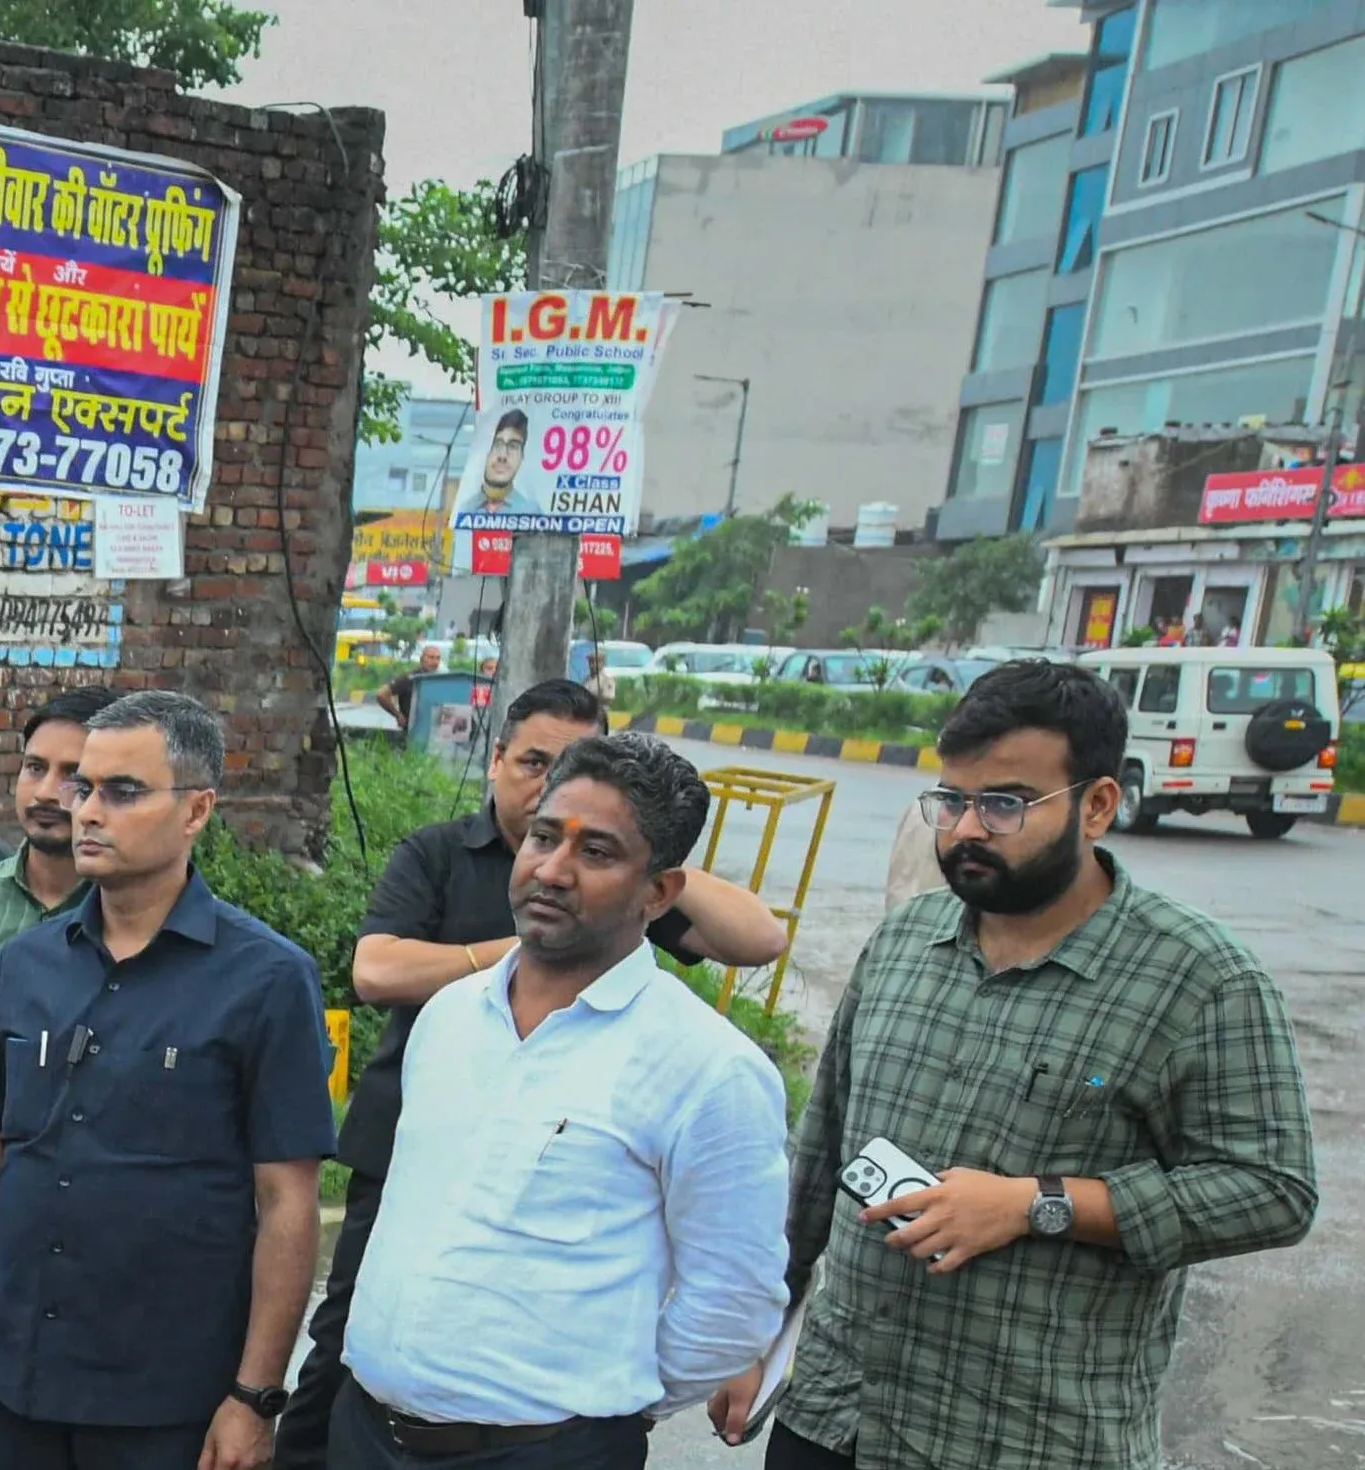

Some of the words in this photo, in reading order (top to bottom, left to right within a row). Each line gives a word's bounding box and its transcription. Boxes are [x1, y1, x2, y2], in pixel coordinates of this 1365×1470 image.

[51, 166, 87, 240] की
[87, 170, 144, 250] वॉटर
[53, 259, 88, 286] और
[5, 262, 35, 335] से
[148, 292, 207, 361] पायें
[491, 293, 649, 345] I.G.M.
[546, 345, 590, 359] Public
[594, 345, 644, 359] School
[0, 356, 29, 382] रवि
[34, 366, 75, 393] गुप्ता
[533, 393, 579, 404] GROUP
[582, 393, 599, 404] TO
[51, 392, 193, 442] एक्सपर्ट
[541, 424, 628, 473] 98%
[559, 476, 570, 488] X
[574, 475, 619, 488] Class
[550, 491, 621, 513] ISHAN
[460, 515, 563, 532] ADMISSION
[569, 517, 623, 532] OPEN
